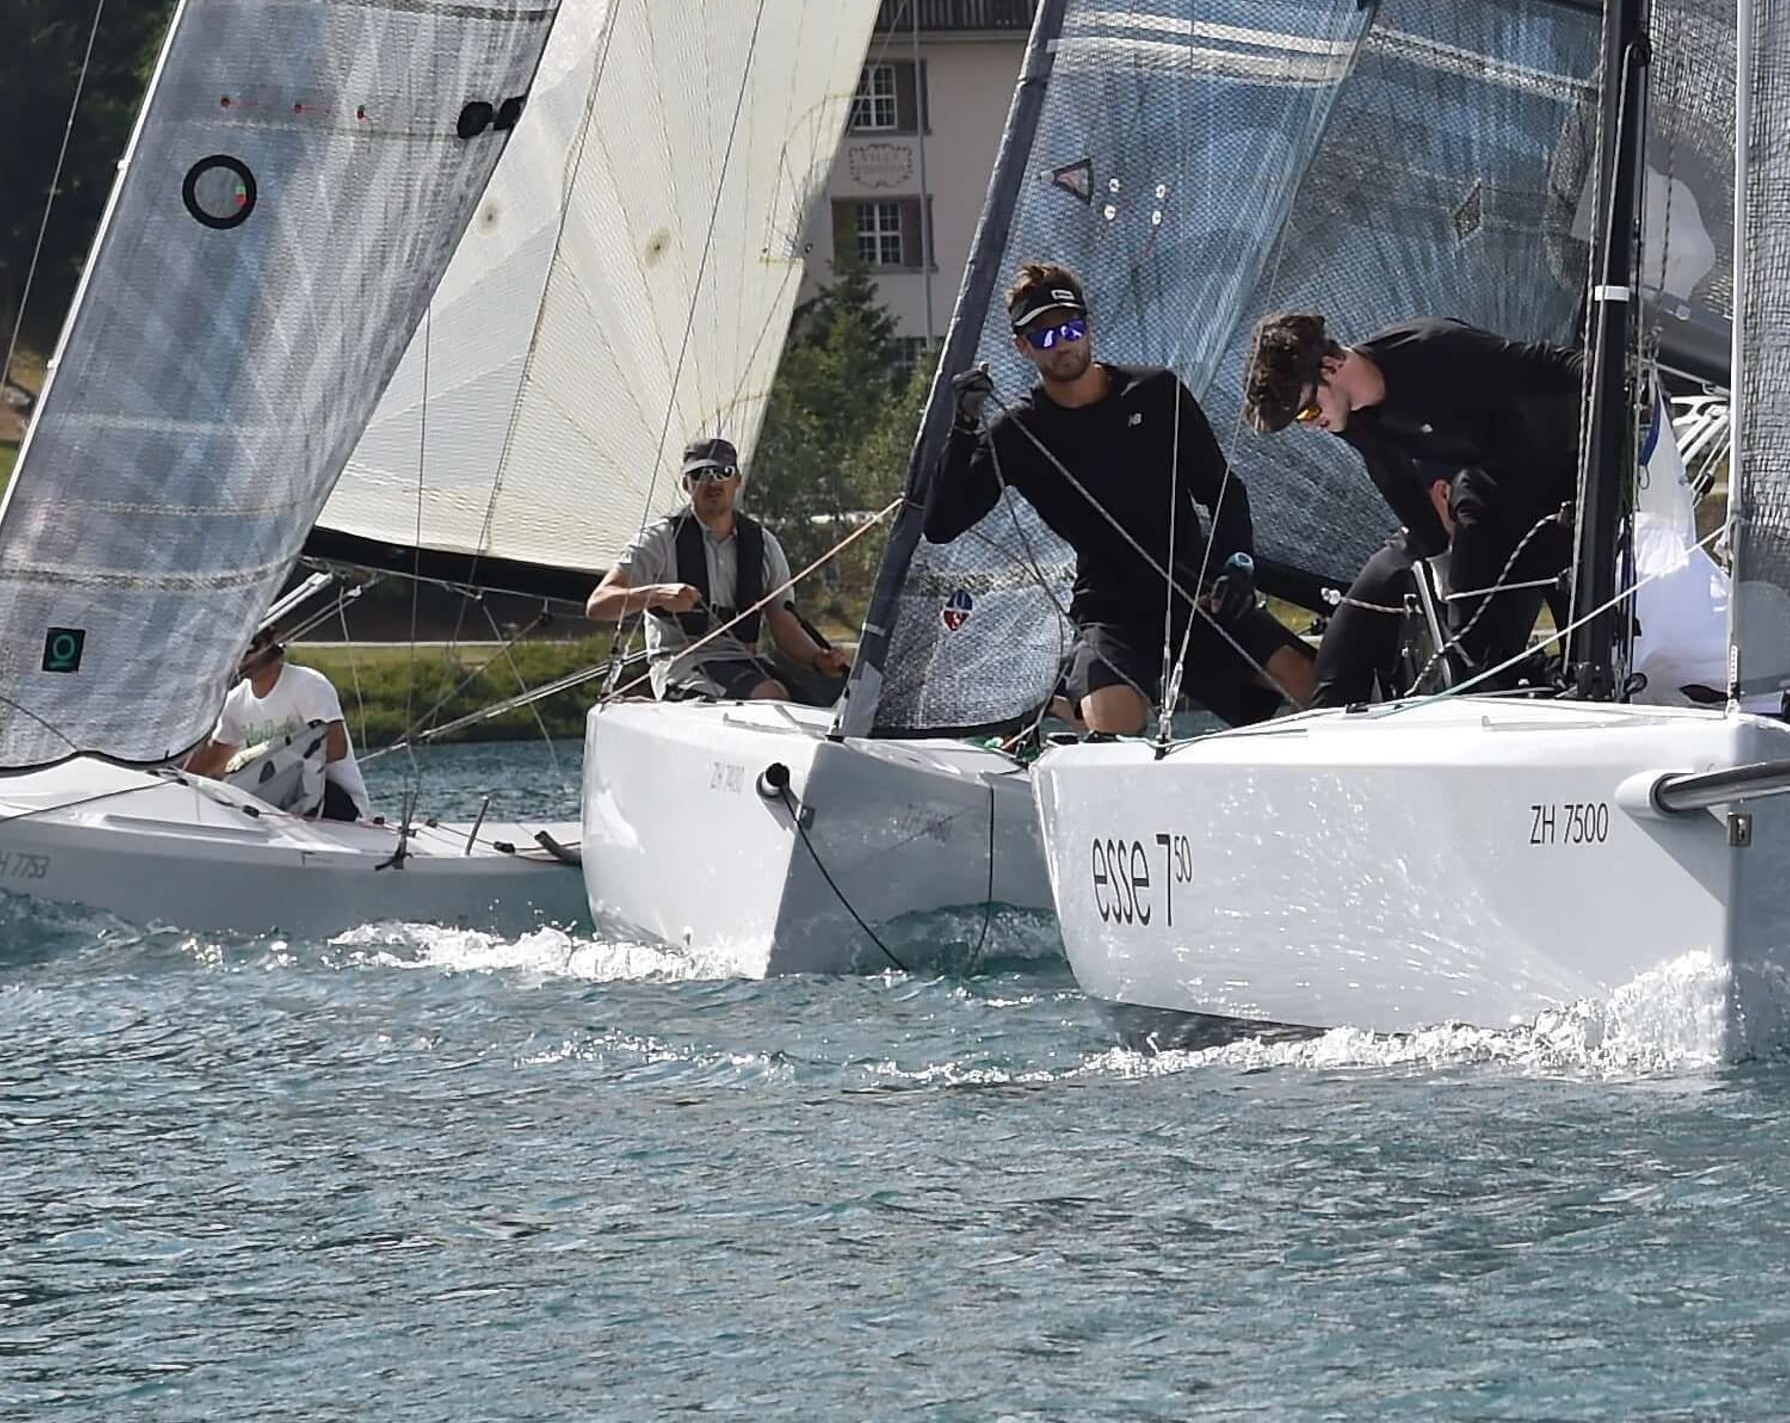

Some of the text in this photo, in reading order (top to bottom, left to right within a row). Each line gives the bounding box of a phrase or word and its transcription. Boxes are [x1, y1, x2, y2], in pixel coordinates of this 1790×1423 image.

[1530, 803, 1608, 844] ZH 7500
[1092, 838, 1151, 927] esse
